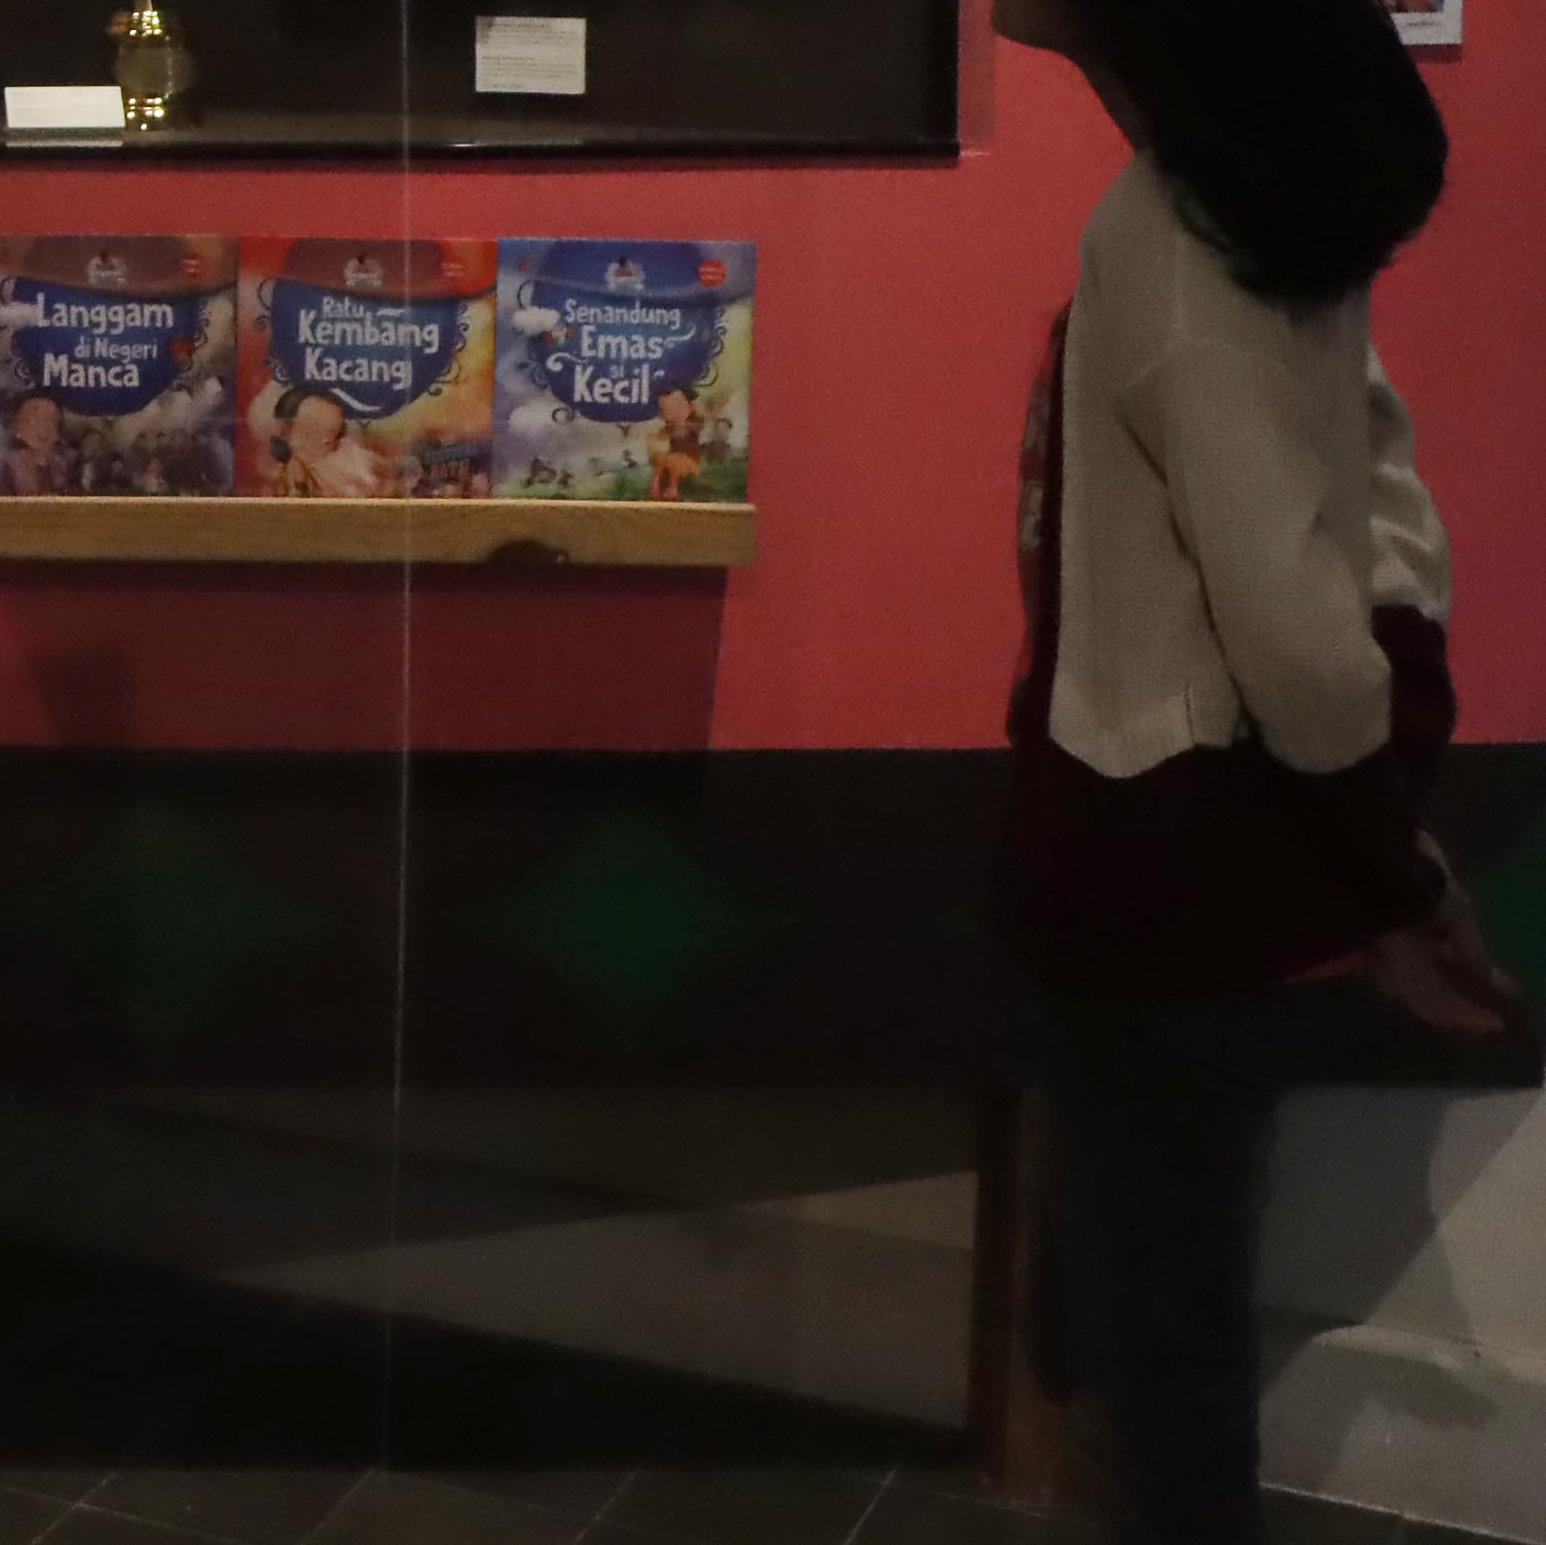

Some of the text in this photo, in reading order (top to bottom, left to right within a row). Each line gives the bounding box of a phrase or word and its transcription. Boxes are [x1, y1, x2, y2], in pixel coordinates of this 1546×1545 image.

[35, 291, 175, 335] Langgam
[321, 297, 366, 319] Ratu
[564, 298, 682, 330] Senandung
[73, 335, 159, 363] di Negeri
[297, 309, 440, 355] Kembang
[580, 324, 665, 360] Emas
[42, 352, 141, 388] Manca
[304, 346, 413, 391] Kacang
[572, 364, 651, 404] Kecil
